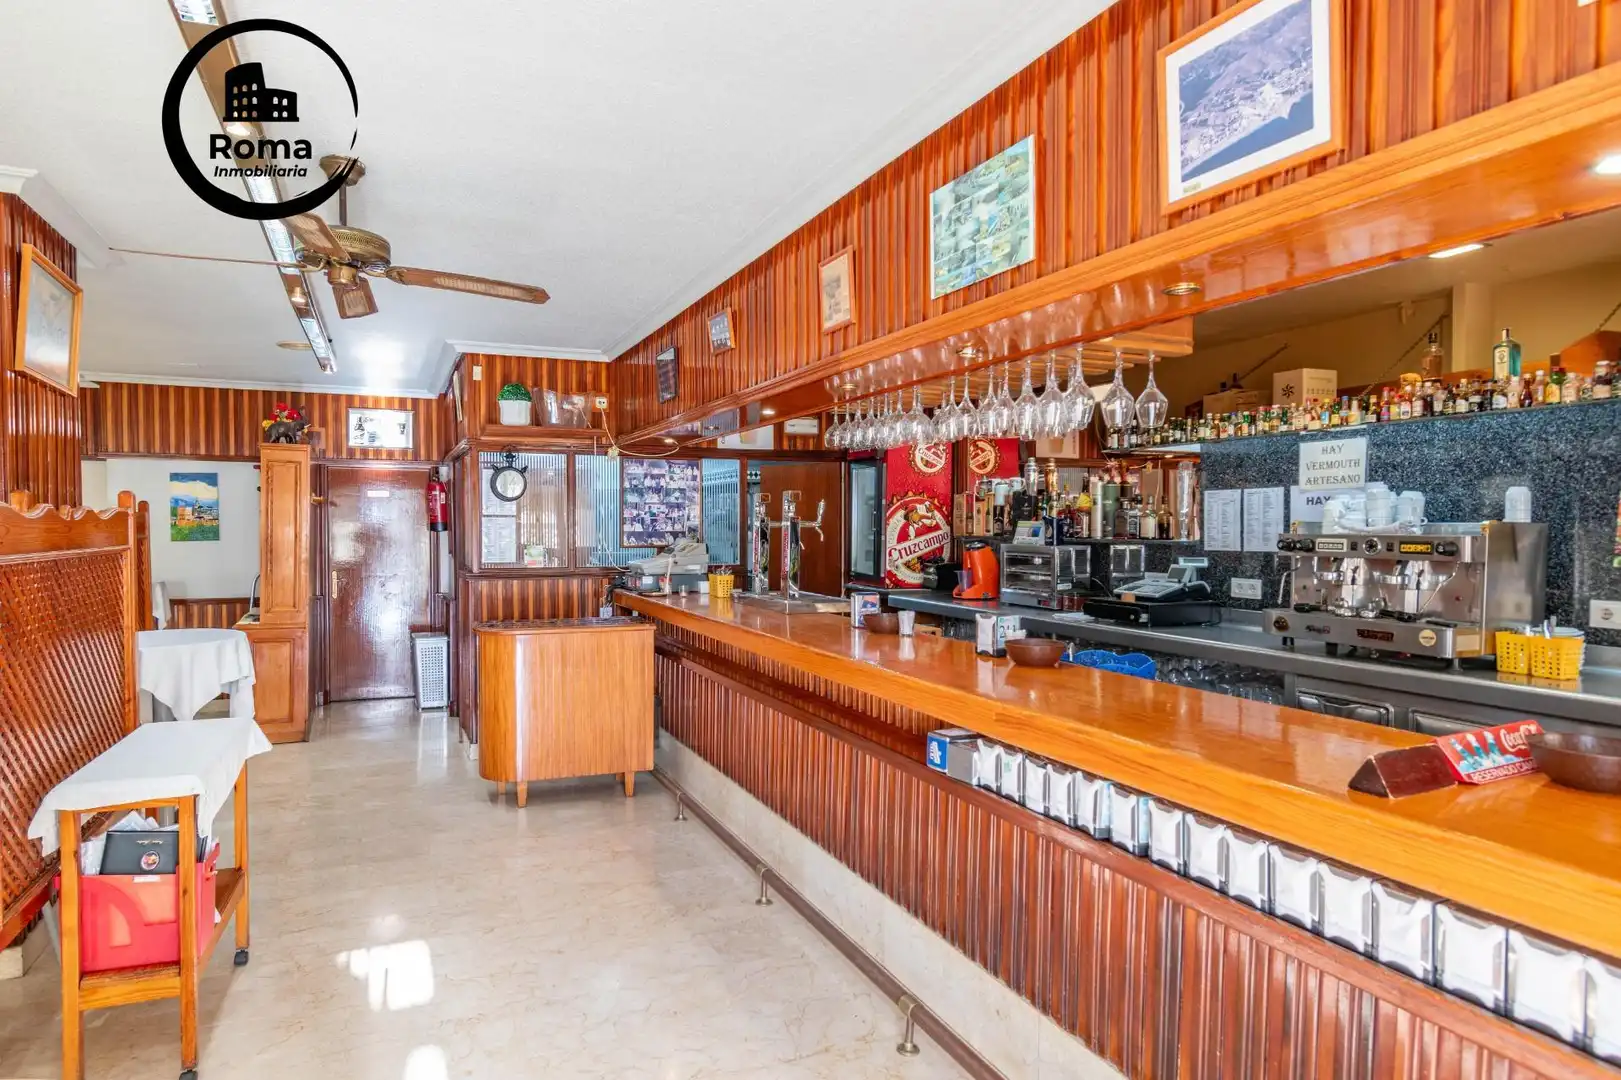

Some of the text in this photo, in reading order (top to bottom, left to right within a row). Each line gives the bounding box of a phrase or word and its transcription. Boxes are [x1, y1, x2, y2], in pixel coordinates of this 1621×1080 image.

[1321, 443, 1344, 455] HAY
[1306, 459, 1361, 471] VERMOUTH
[1305, 475, 1361, 486] ARTESANO
[1306, 496, 1331, 506] HAY
[888, 531, 949, 562] Cruzcampo
[1470, 764, 1517, 782] RESERVADO
